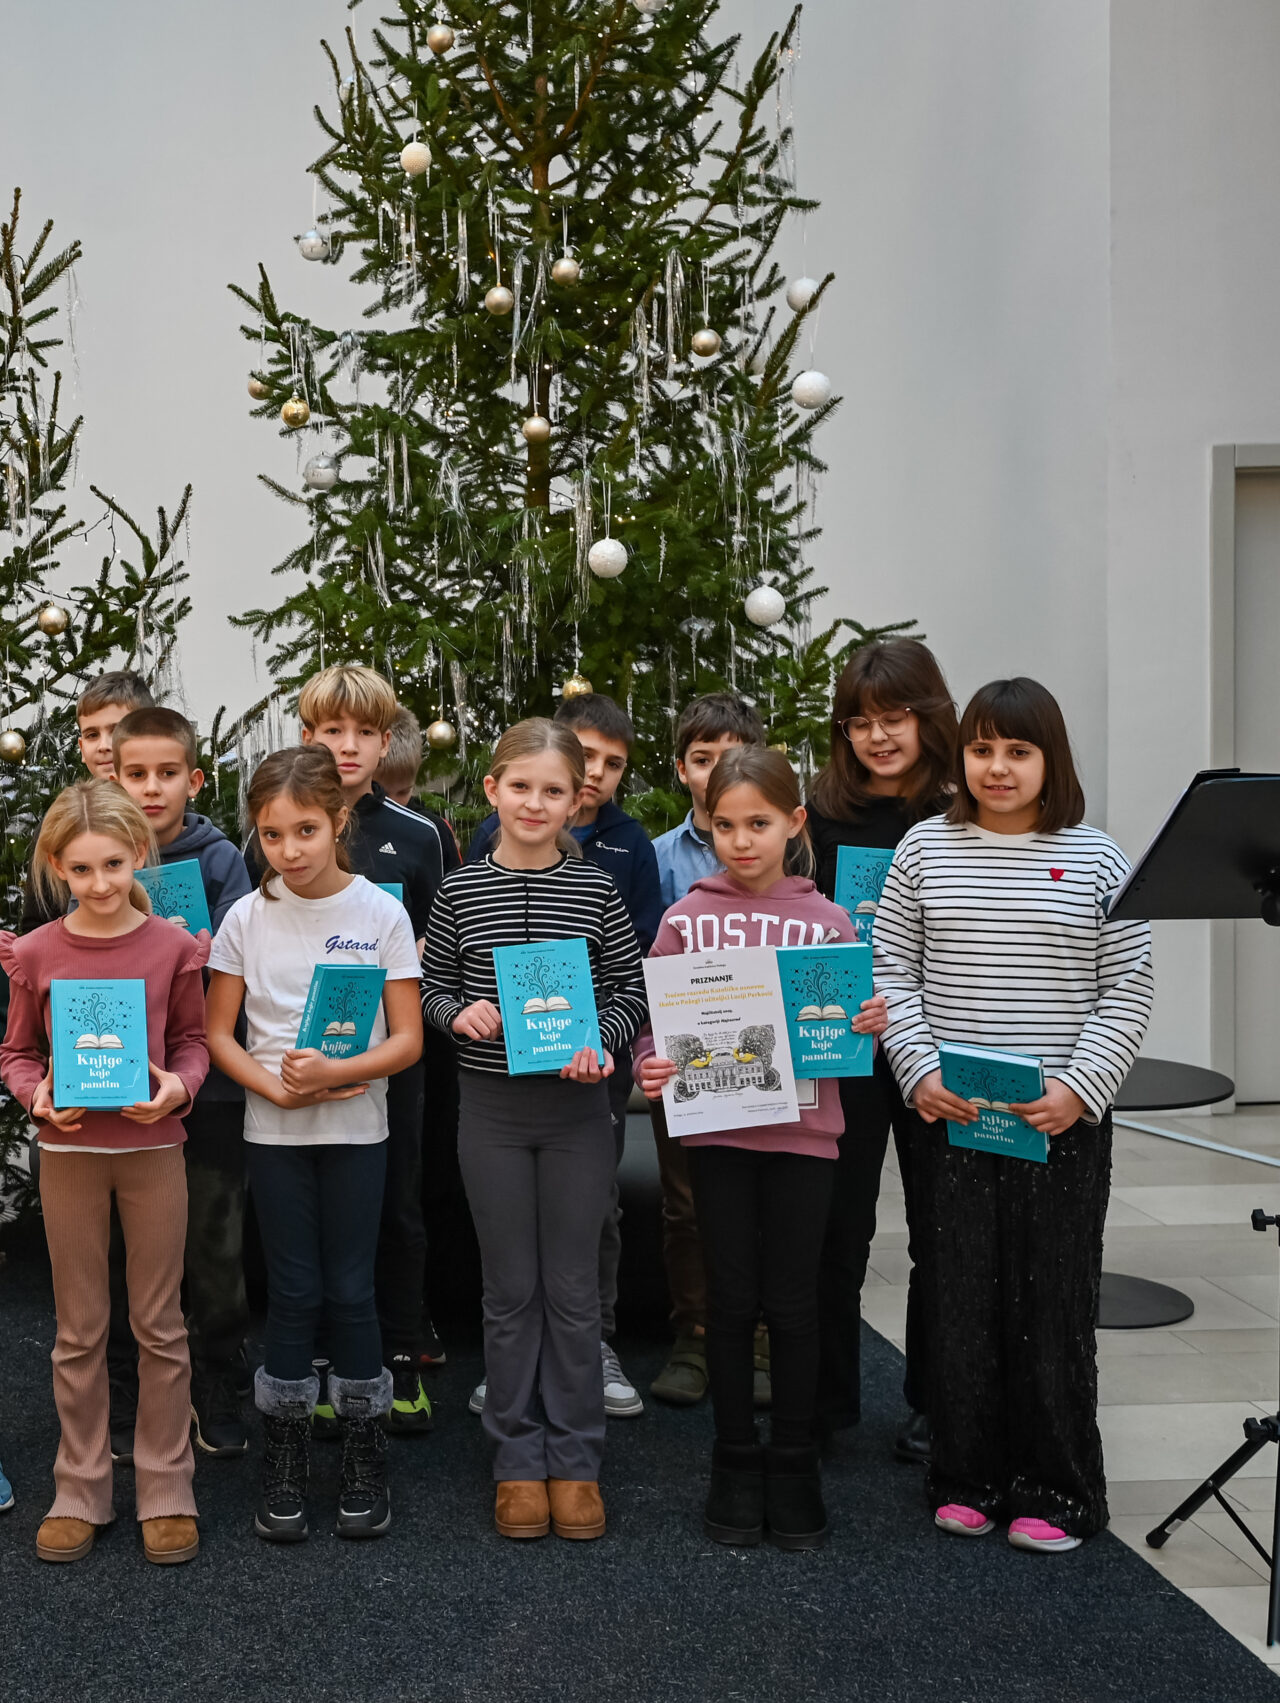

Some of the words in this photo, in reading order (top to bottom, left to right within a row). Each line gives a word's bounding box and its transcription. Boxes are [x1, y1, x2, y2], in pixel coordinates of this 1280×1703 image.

[668, 912, 840, 954] BOSTON
[325, 935, 379, 954] Gstaad
[691, 975, 733, 985] PRIZNANJE
[526, 1018, 572, 1032] Knjige
[540, 1032, 561, 1041] koje
[799, 1026, 846, 1040] Knjige
[321, 1041, 351, 1054] Knjige
[532, 1043, 572, 1055] pamtim
[812, 1040, 832, 1050] koje
[76, 1054, 122, 1068] Knjige
[802, 1052, 842, 1063] pamtim
[90, 1068, 110, 1079] koje
[81, 1080, 119, 1090] pamtim
[979, 1115, 1016, 1128] njige
[974, 1132, 1014, 1143] pamtim
